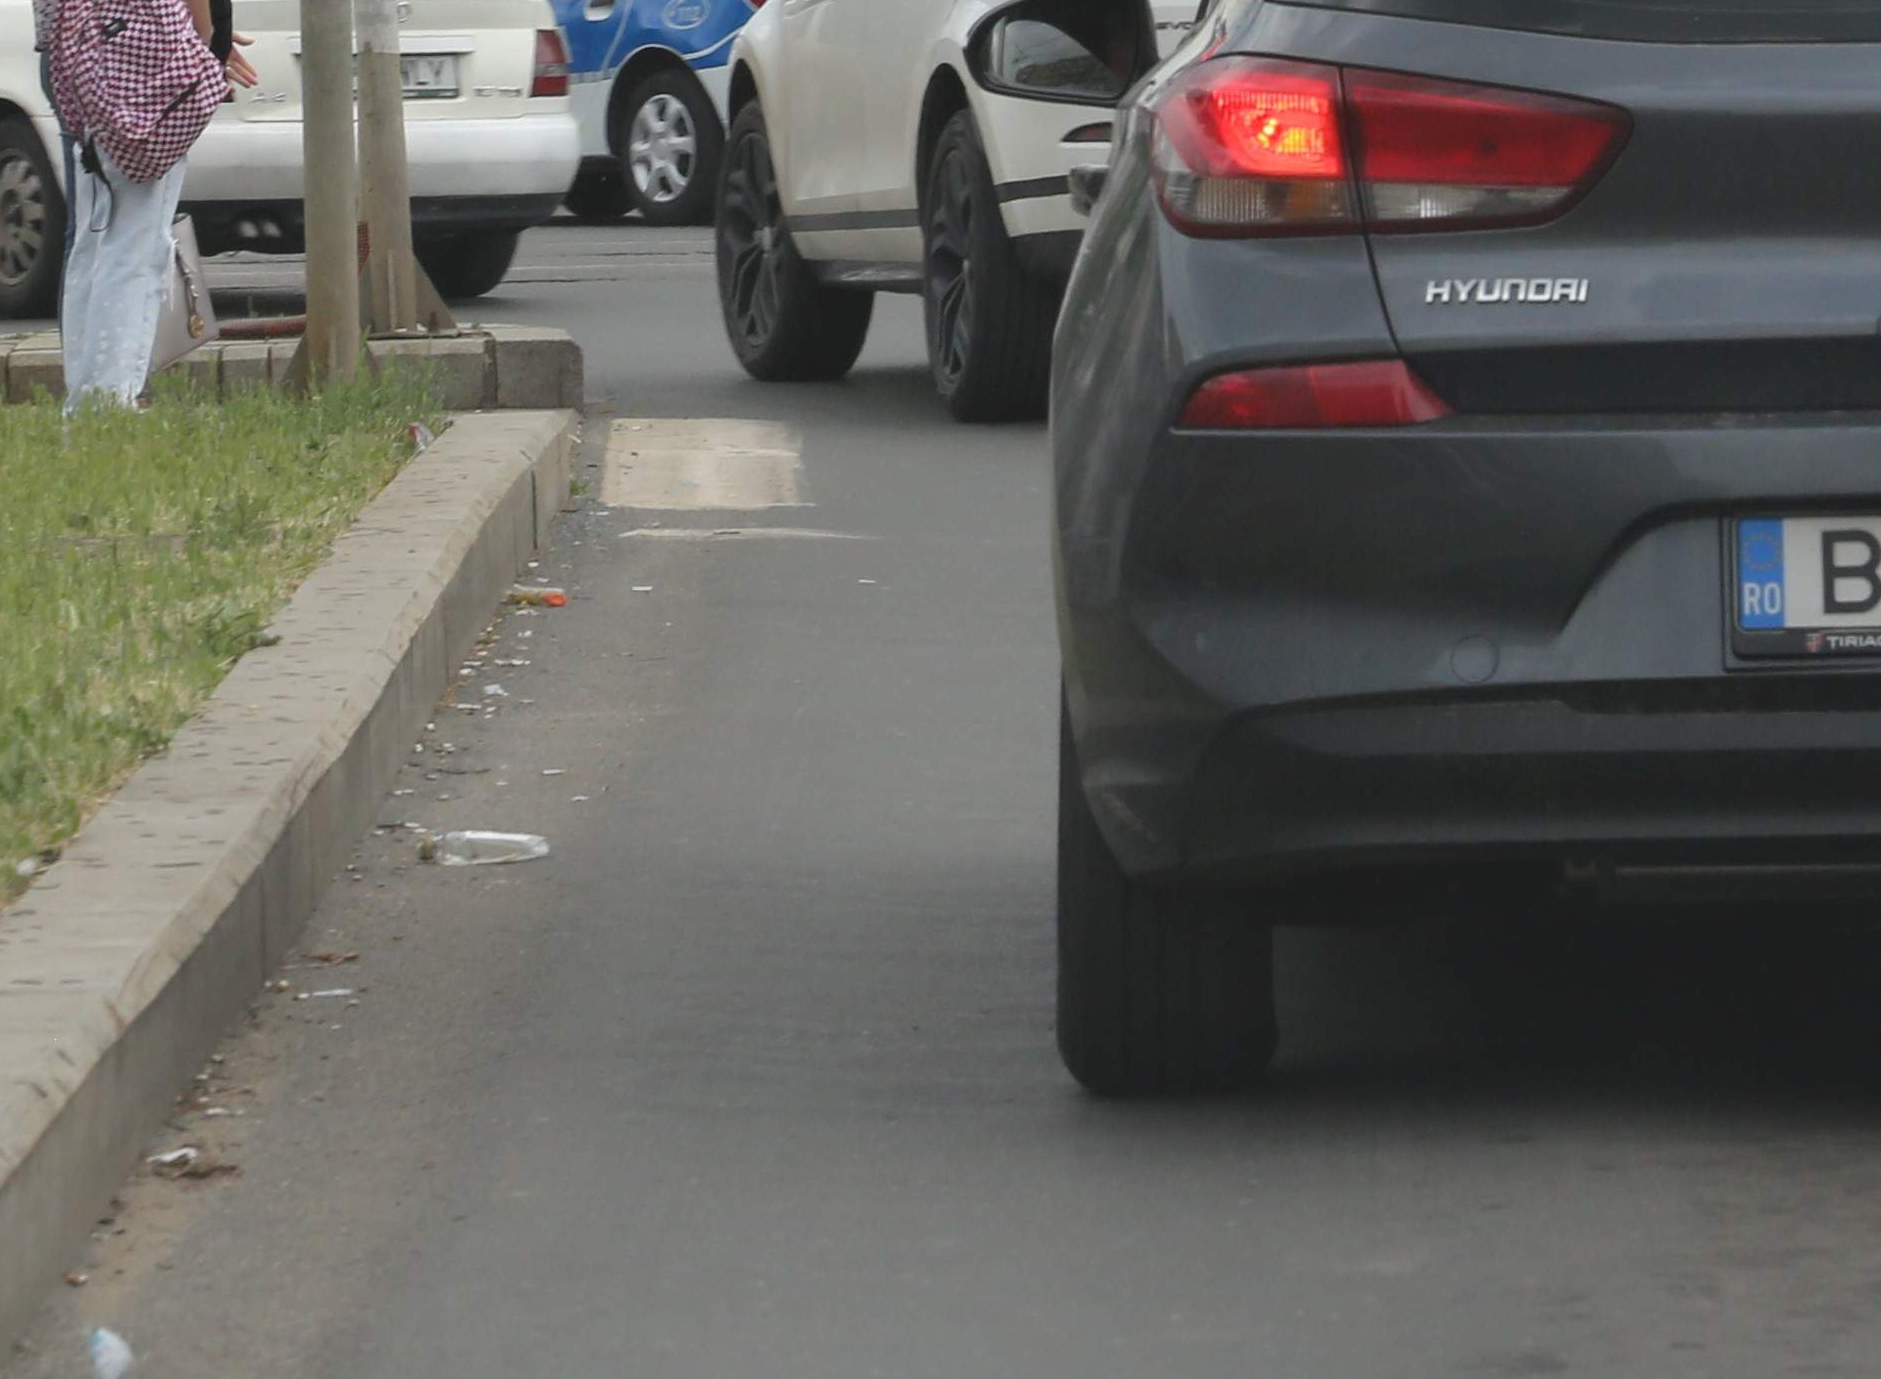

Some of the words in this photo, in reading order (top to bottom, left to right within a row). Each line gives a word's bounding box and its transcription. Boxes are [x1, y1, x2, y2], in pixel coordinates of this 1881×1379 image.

[1424, 277, 1590, 304] HYUNDAI
[1820, 529, 1881, 615] B
[1742, 582, 1784, 617] RO
